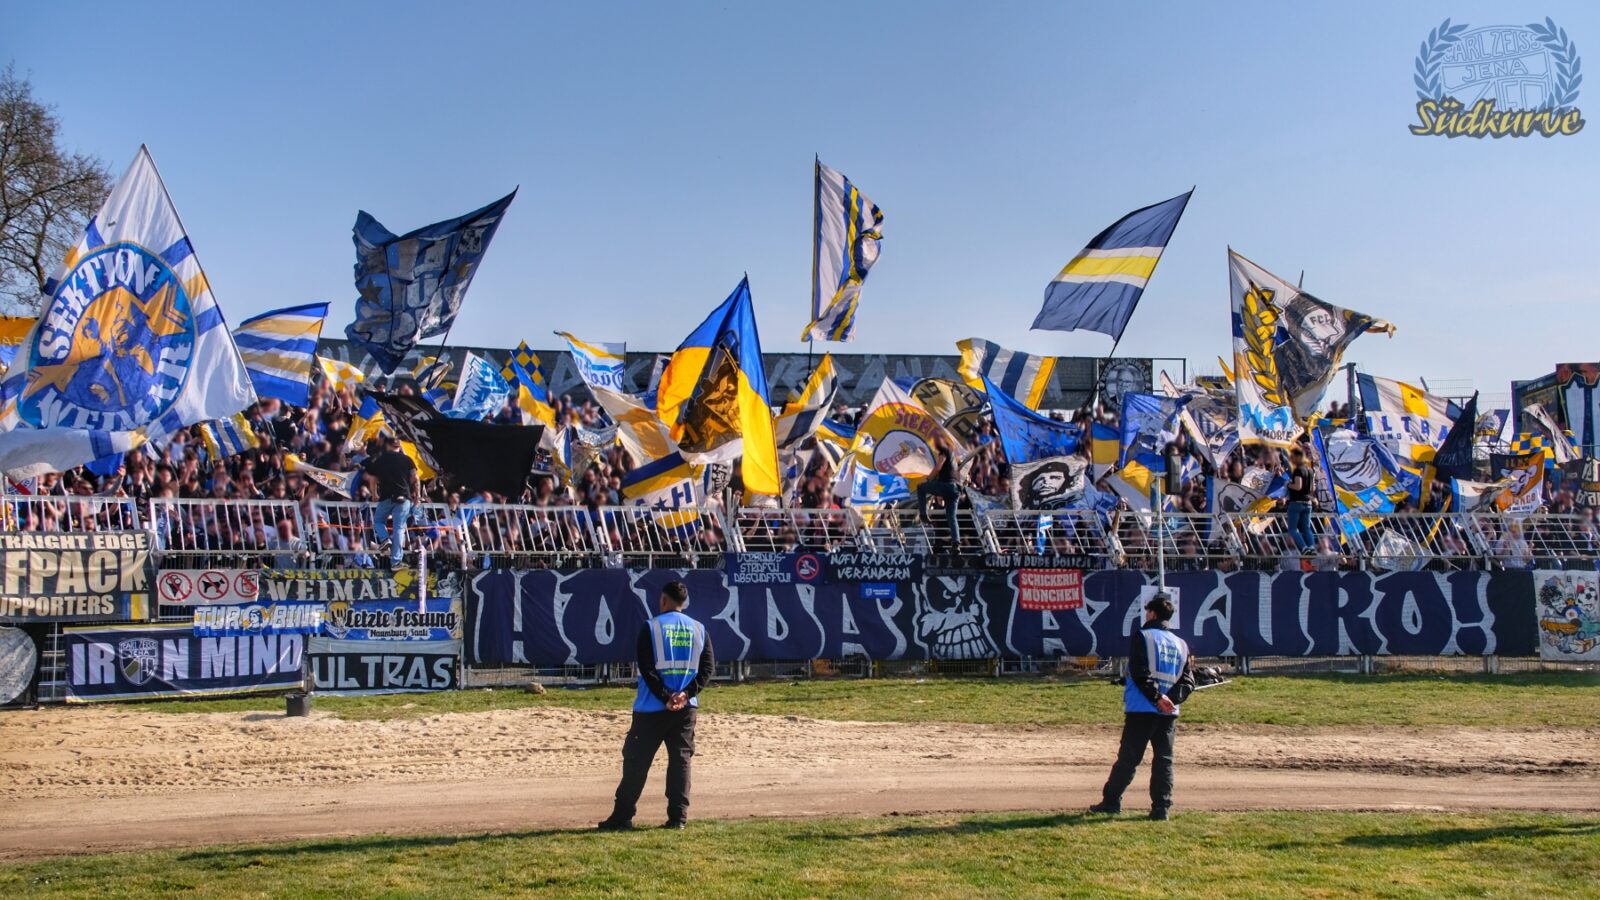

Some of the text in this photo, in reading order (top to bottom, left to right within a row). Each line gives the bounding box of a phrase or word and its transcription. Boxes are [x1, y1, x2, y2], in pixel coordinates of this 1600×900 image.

[94, 534, 147, 550] EDGE
[861, 553, 915, 565] RADIKAL
[0, 550, 149, 594] FPACK
[837, 566, 911, 580] VERÄNDERN
[1021, 573, 1078, 586] SCHICKERIA
[265, 578, 400, 602] WEIMAR
[1022, 586, 1080, 603] MÜNCHEN
[345, 609, 391, 628] Letzte
[201, 634, 303, 680] MIND
[312, 655, 454, 689] ULTRAS
